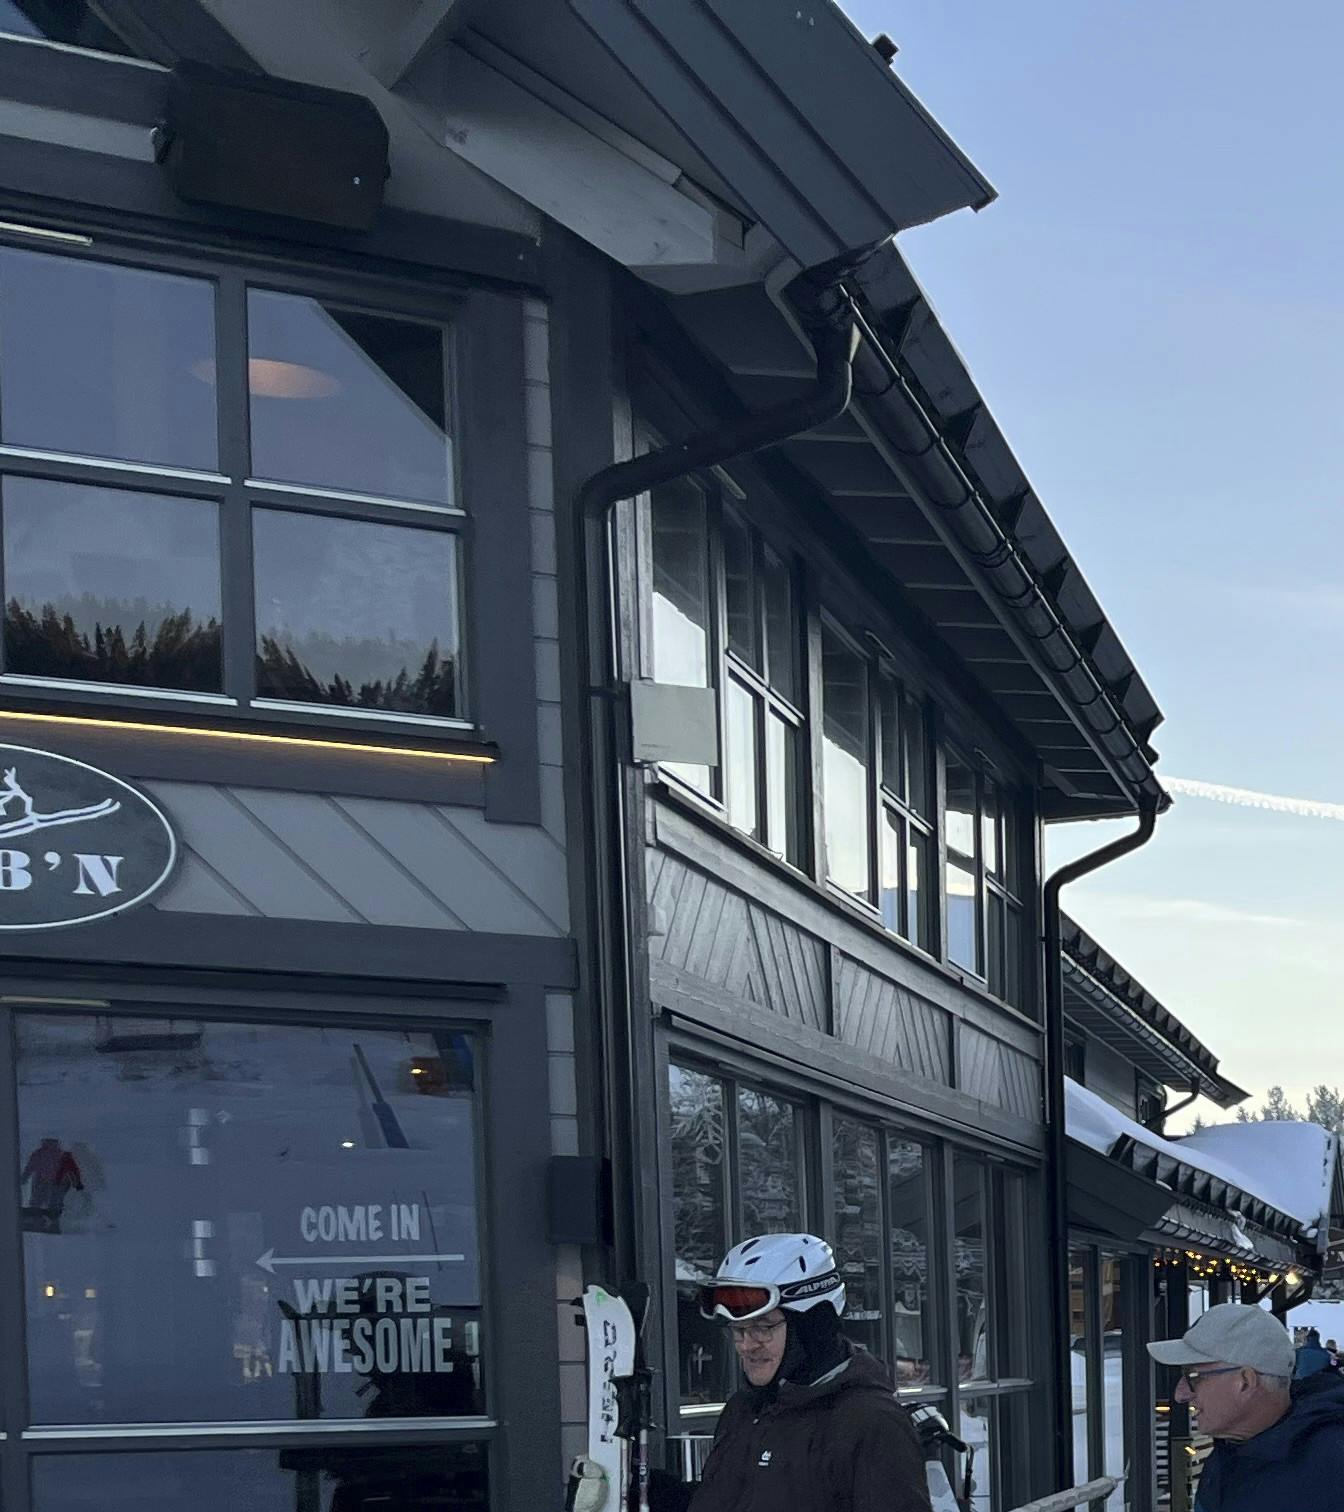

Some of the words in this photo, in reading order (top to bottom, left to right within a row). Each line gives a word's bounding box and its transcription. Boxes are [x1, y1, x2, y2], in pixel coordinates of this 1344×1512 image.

[301, 1205, 383, 1241] COME
[391, 1204, 420, 1240] IN
[294, 1277, 431, 1313] WE'RE
[278, 1317, 454, 1374] AWESOME
